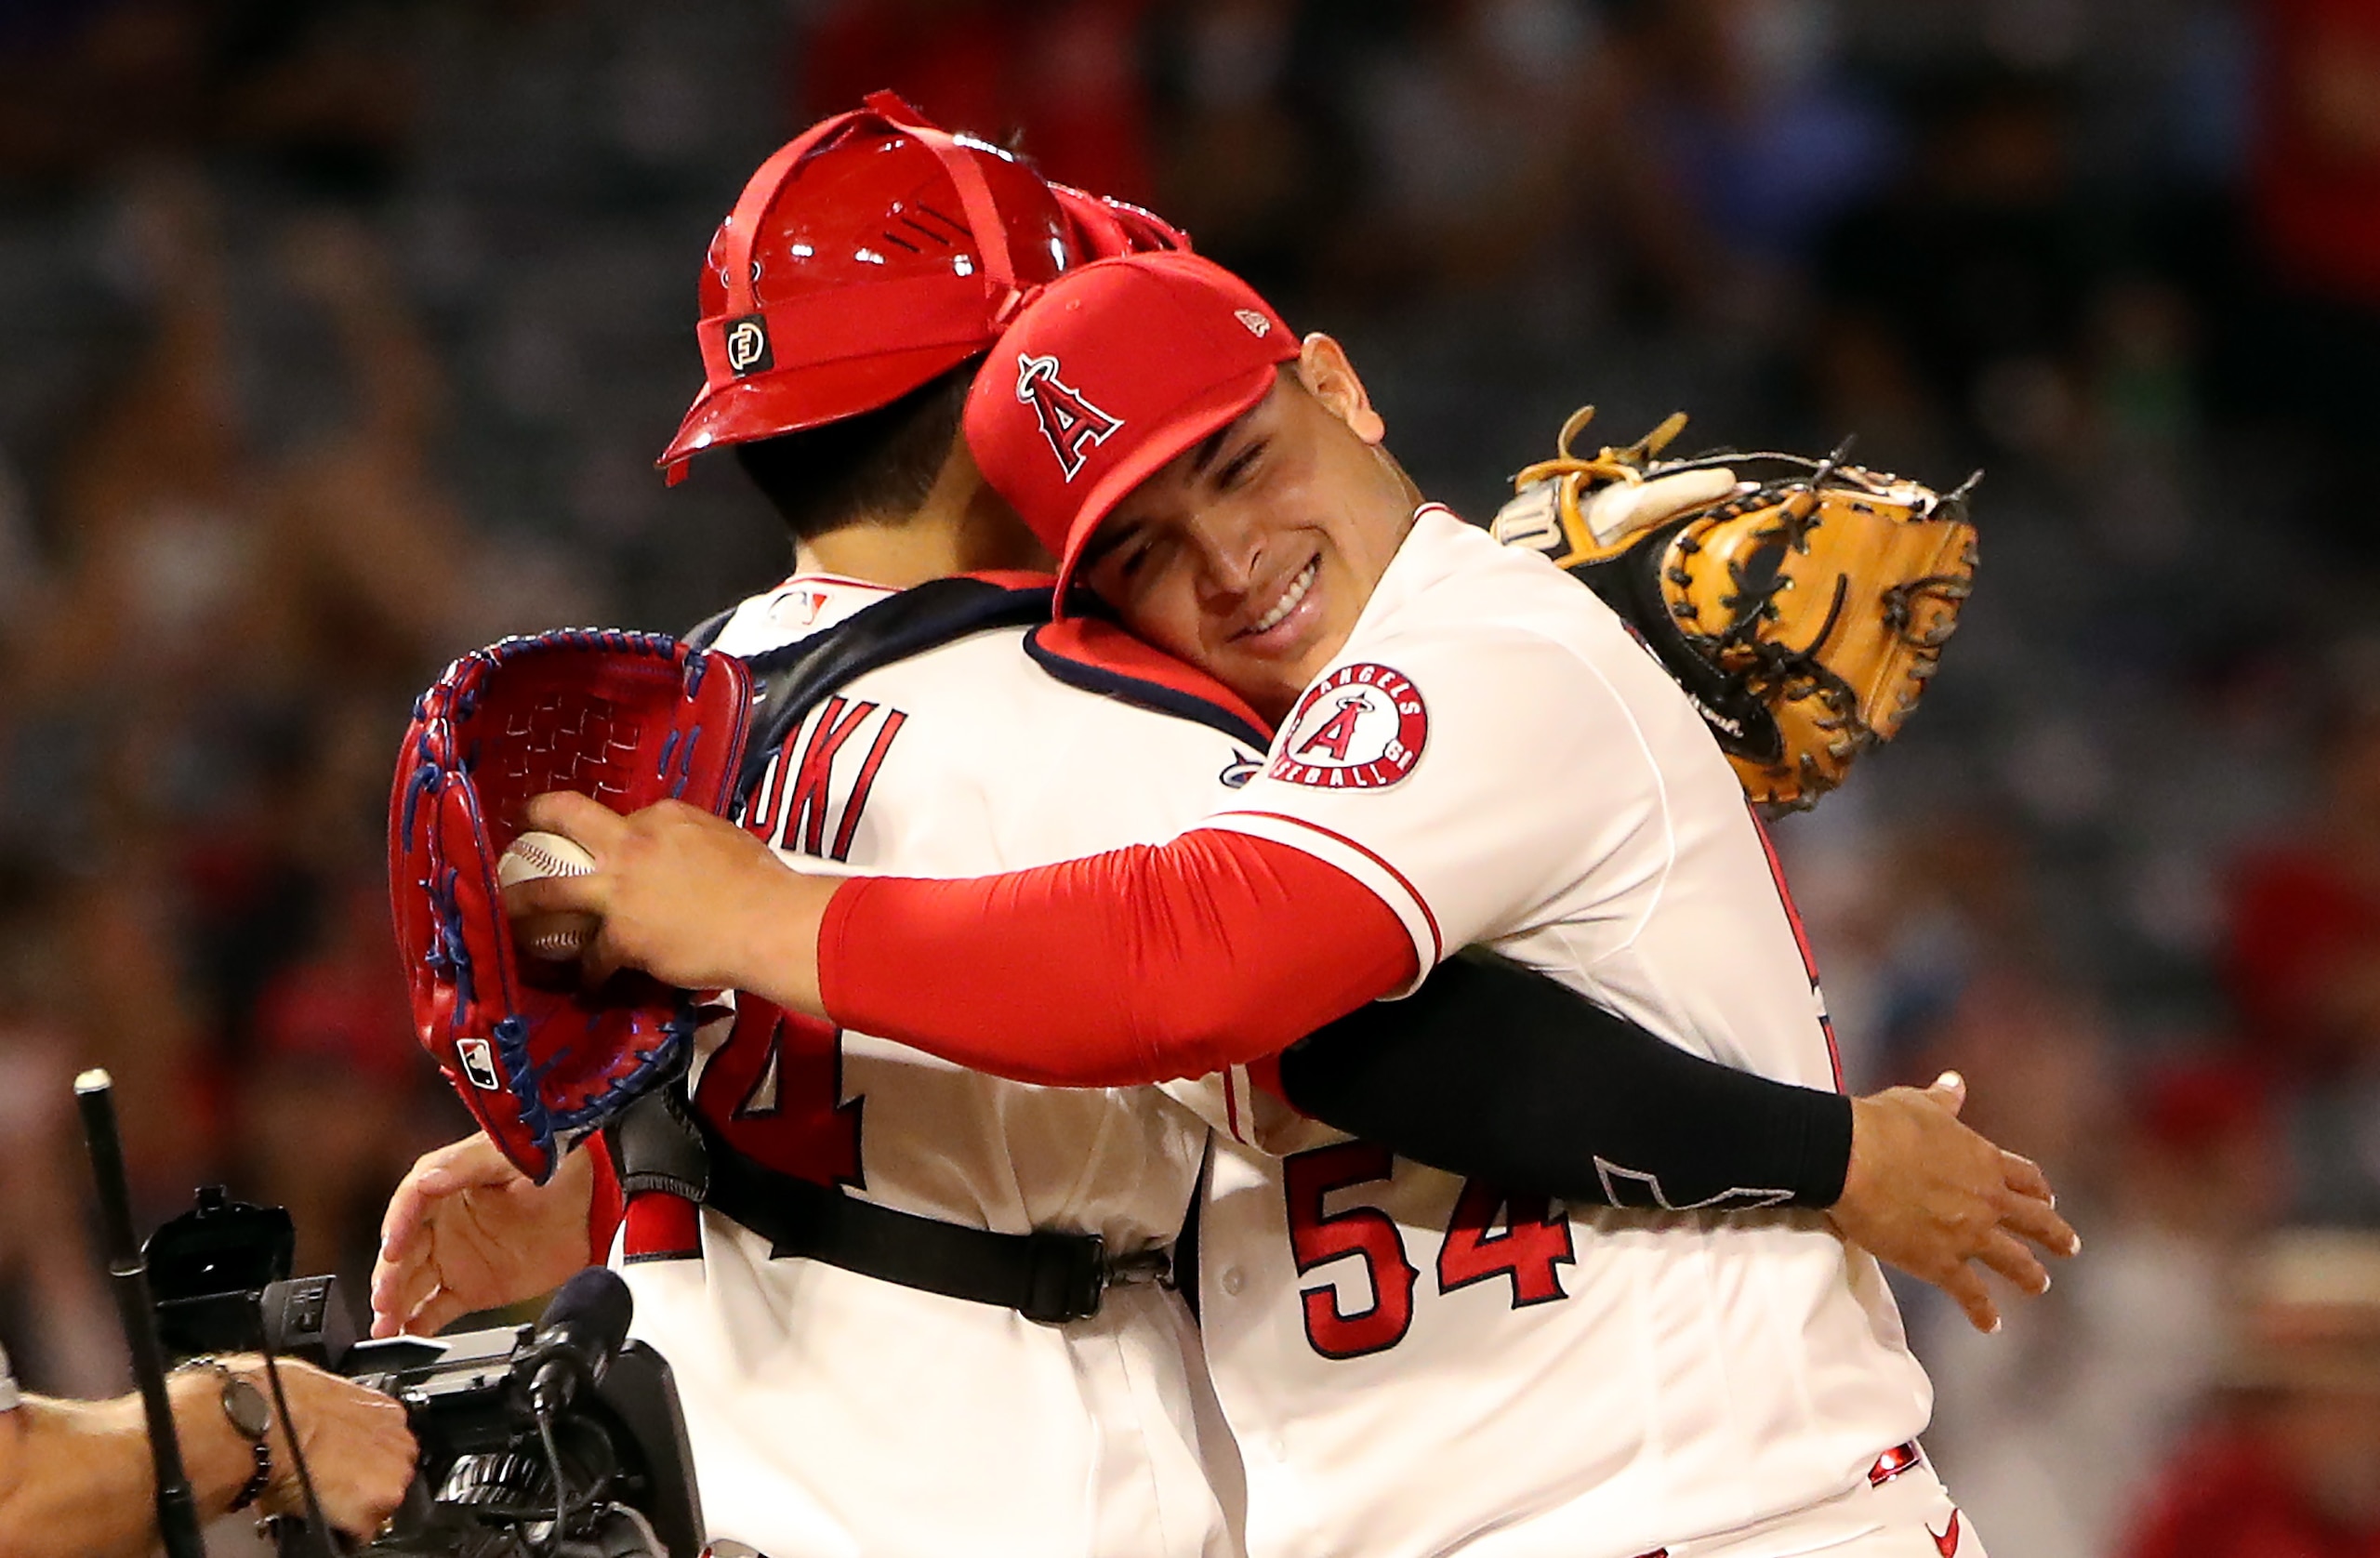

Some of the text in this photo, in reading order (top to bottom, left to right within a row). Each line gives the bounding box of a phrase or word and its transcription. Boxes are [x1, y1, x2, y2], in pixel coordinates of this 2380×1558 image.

[1017, 353, 1126, 483] A
[1296, 692, 1375, 761] A
[1320, 666, 1421, 715] ANGELS
[743, 695, 909, 863] UKI
[1272, 758, 1386, 786] SEBALL
[1283, 1137, 1576, 1361] 54
